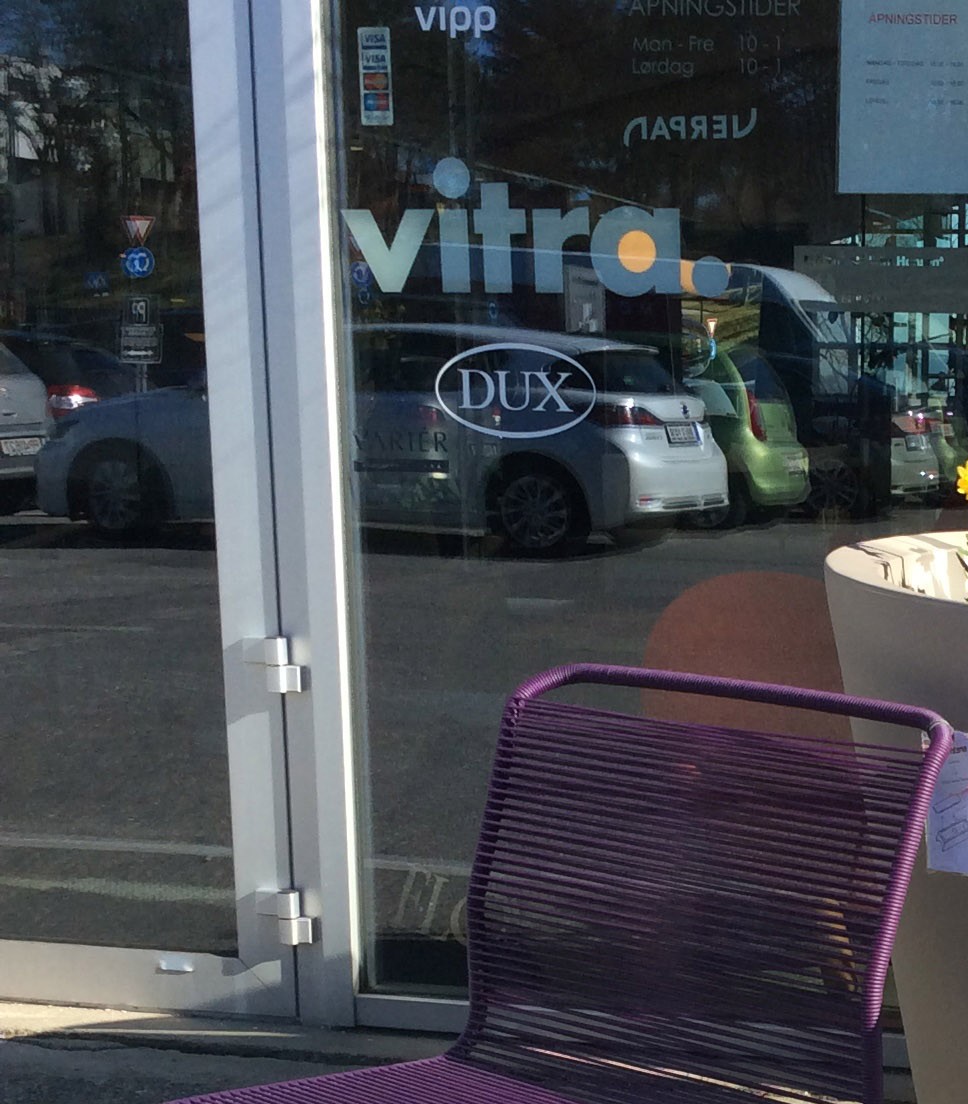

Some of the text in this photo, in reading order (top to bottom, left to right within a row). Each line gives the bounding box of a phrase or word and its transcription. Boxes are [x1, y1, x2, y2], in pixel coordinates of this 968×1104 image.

[415, 6, 497, 38] vipp
[364, 33, 387, 43] VISA
[632, 36, 673, 52] Man
[688, 36, 715, 52] Fre
[365, 54, 387, 63] VISA
[631, 58, 695, 78] Lørdag
[457, 368, 574, 413] DUX
[354, 431, 448, 453] VARIER
